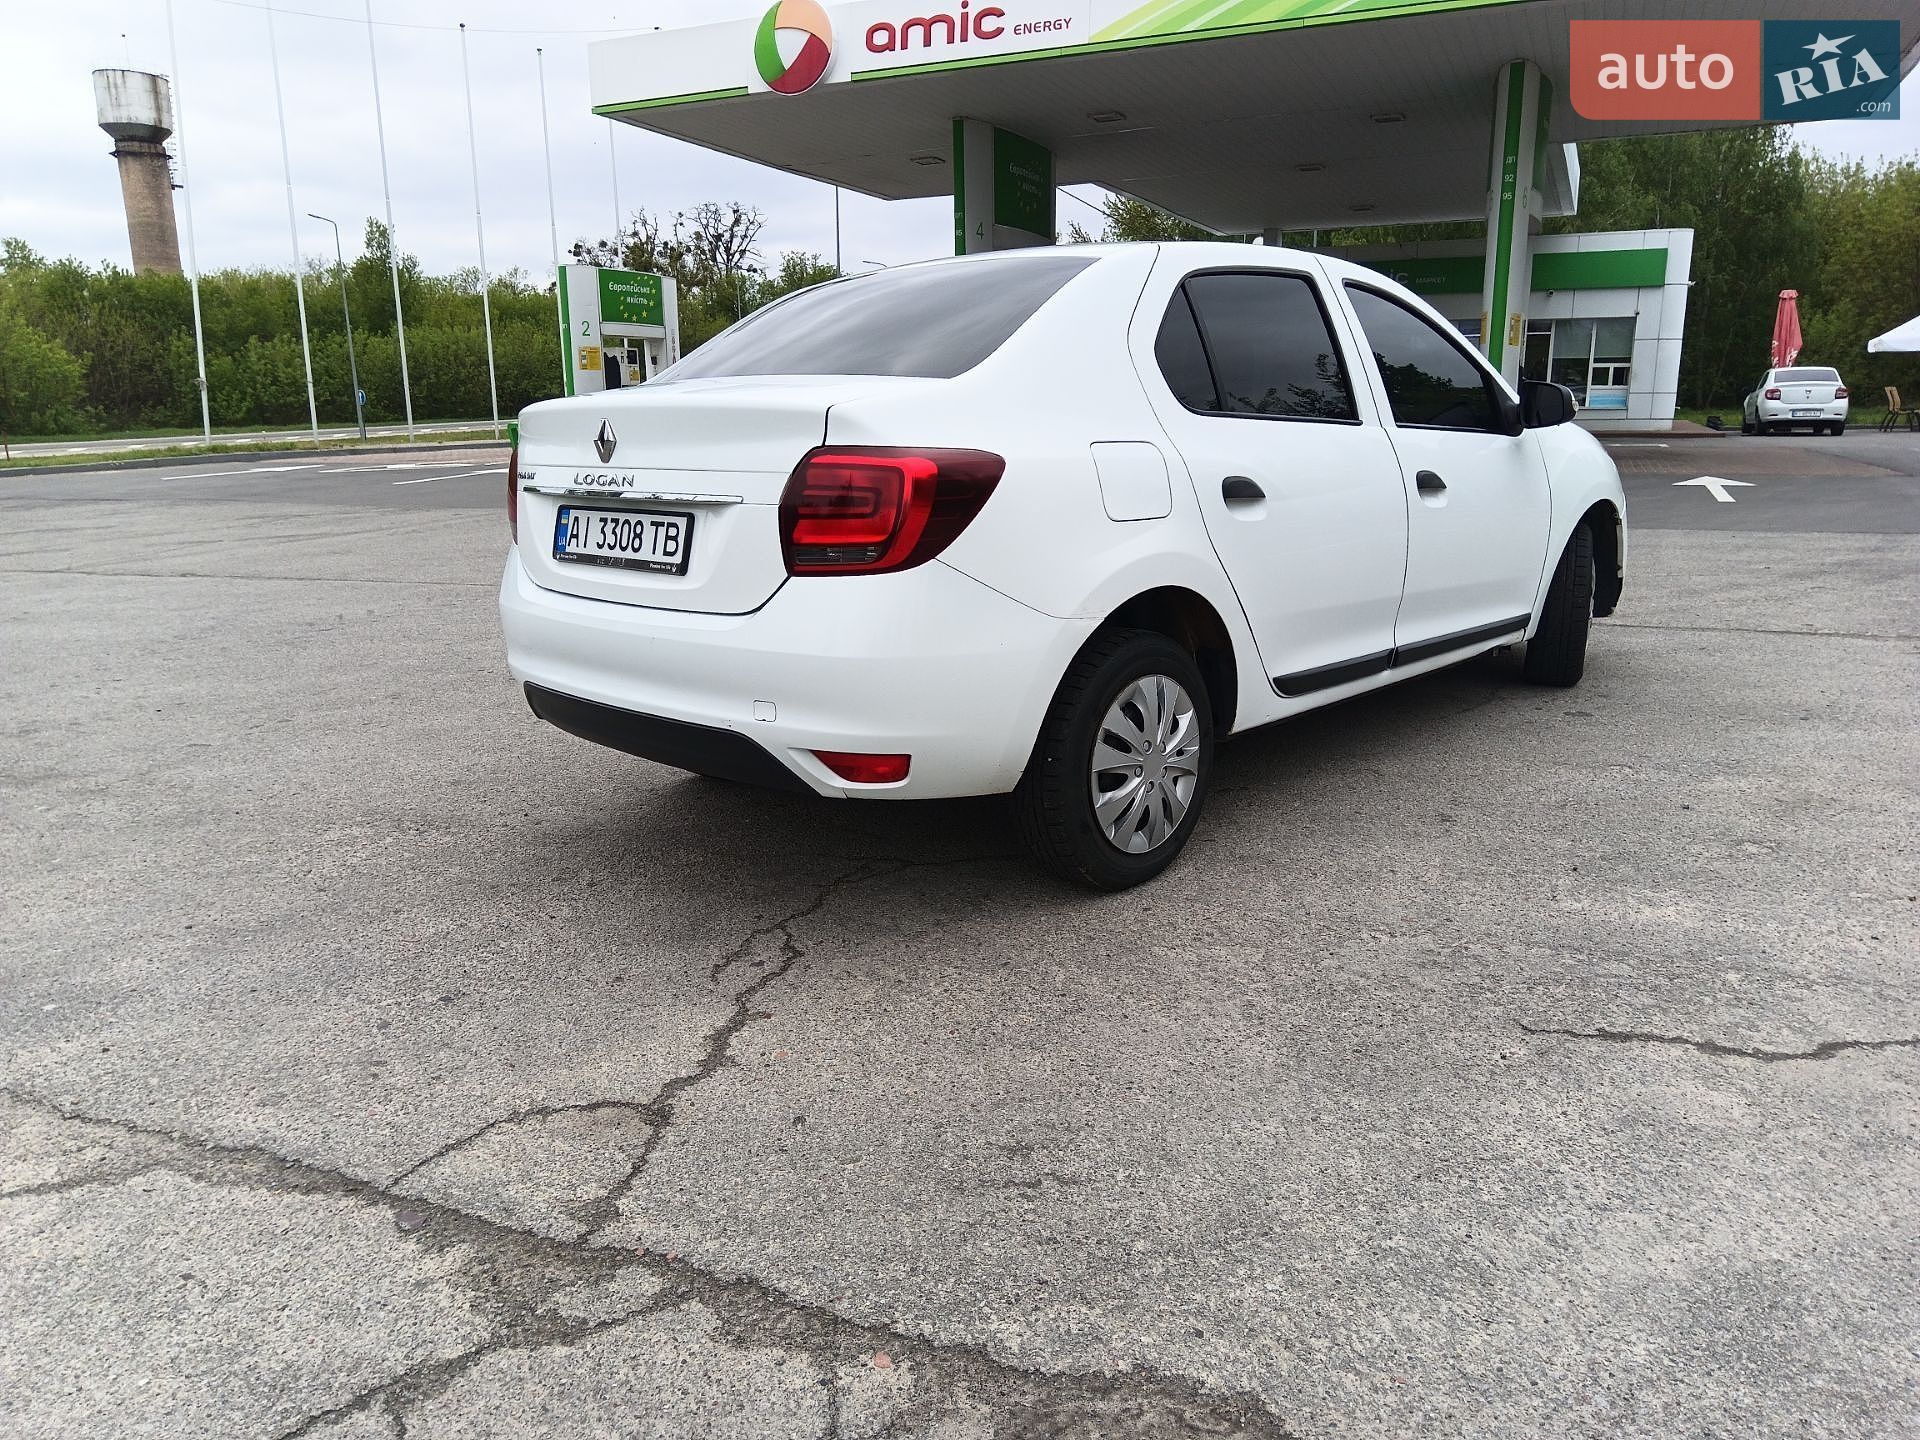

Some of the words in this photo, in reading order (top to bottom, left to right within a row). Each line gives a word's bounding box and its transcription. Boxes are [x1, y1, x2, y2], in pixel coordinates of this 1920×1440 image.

[866, 0, 1005, 53] amic
[1013, 17, 1073, 36] ENERGY
[1502, 192, 1513, 200] 95
[976, 222, 984, 241] 4
[581, 320, 591, 336] 2
[573, 472, 635, 488] LOGAN
[567, 516, 590, 548] AI
[596, 517, 644, 553] 3308
[650, 520, 679, 557] TB
